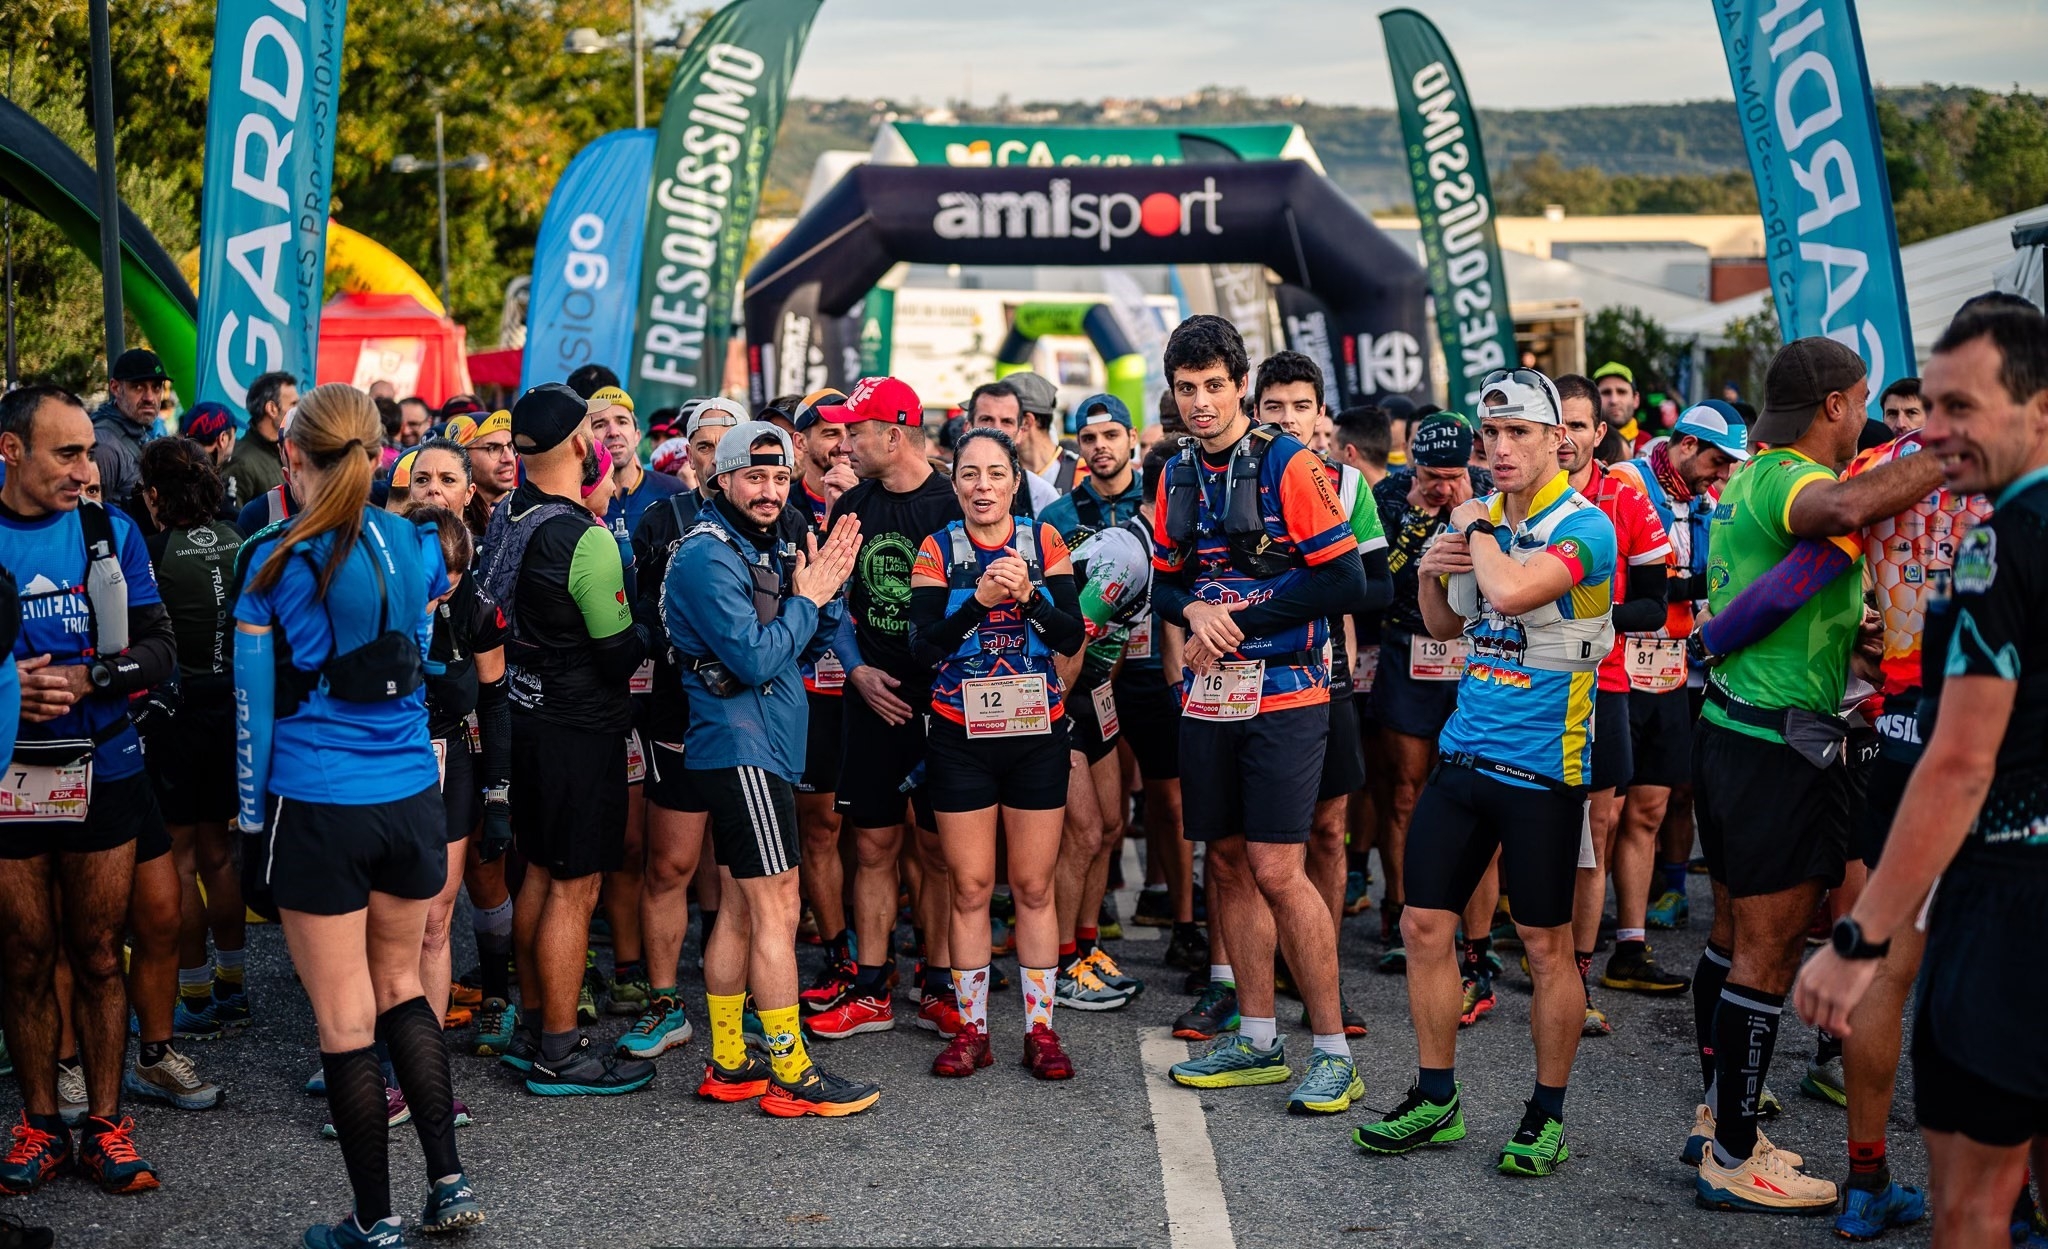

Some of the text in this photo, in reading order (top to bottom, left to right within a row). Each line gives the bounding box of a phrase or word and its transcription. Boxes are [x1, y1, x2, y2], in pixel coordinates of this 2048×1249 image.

[725, 458, 743, 468] TRAIL
[211, 566, 225, 606] TRAIL
[1421, 642, 1447, 656] 130
[1637, 651, 1654, 665] 81
[1204, 675, 1223, 690] 16
[980, 691, 1002, 708] 12
[14, 772, 28, 789] 7
[1506, 767, 1536, 781] Kalenji
[53, 790, 73, 799] 32K
[533, 1061, 557, 1078] SCARPA
[1741, 1015, 1771, 1117] Kalenji
[769, 1083, 795, 1102] HOKA
